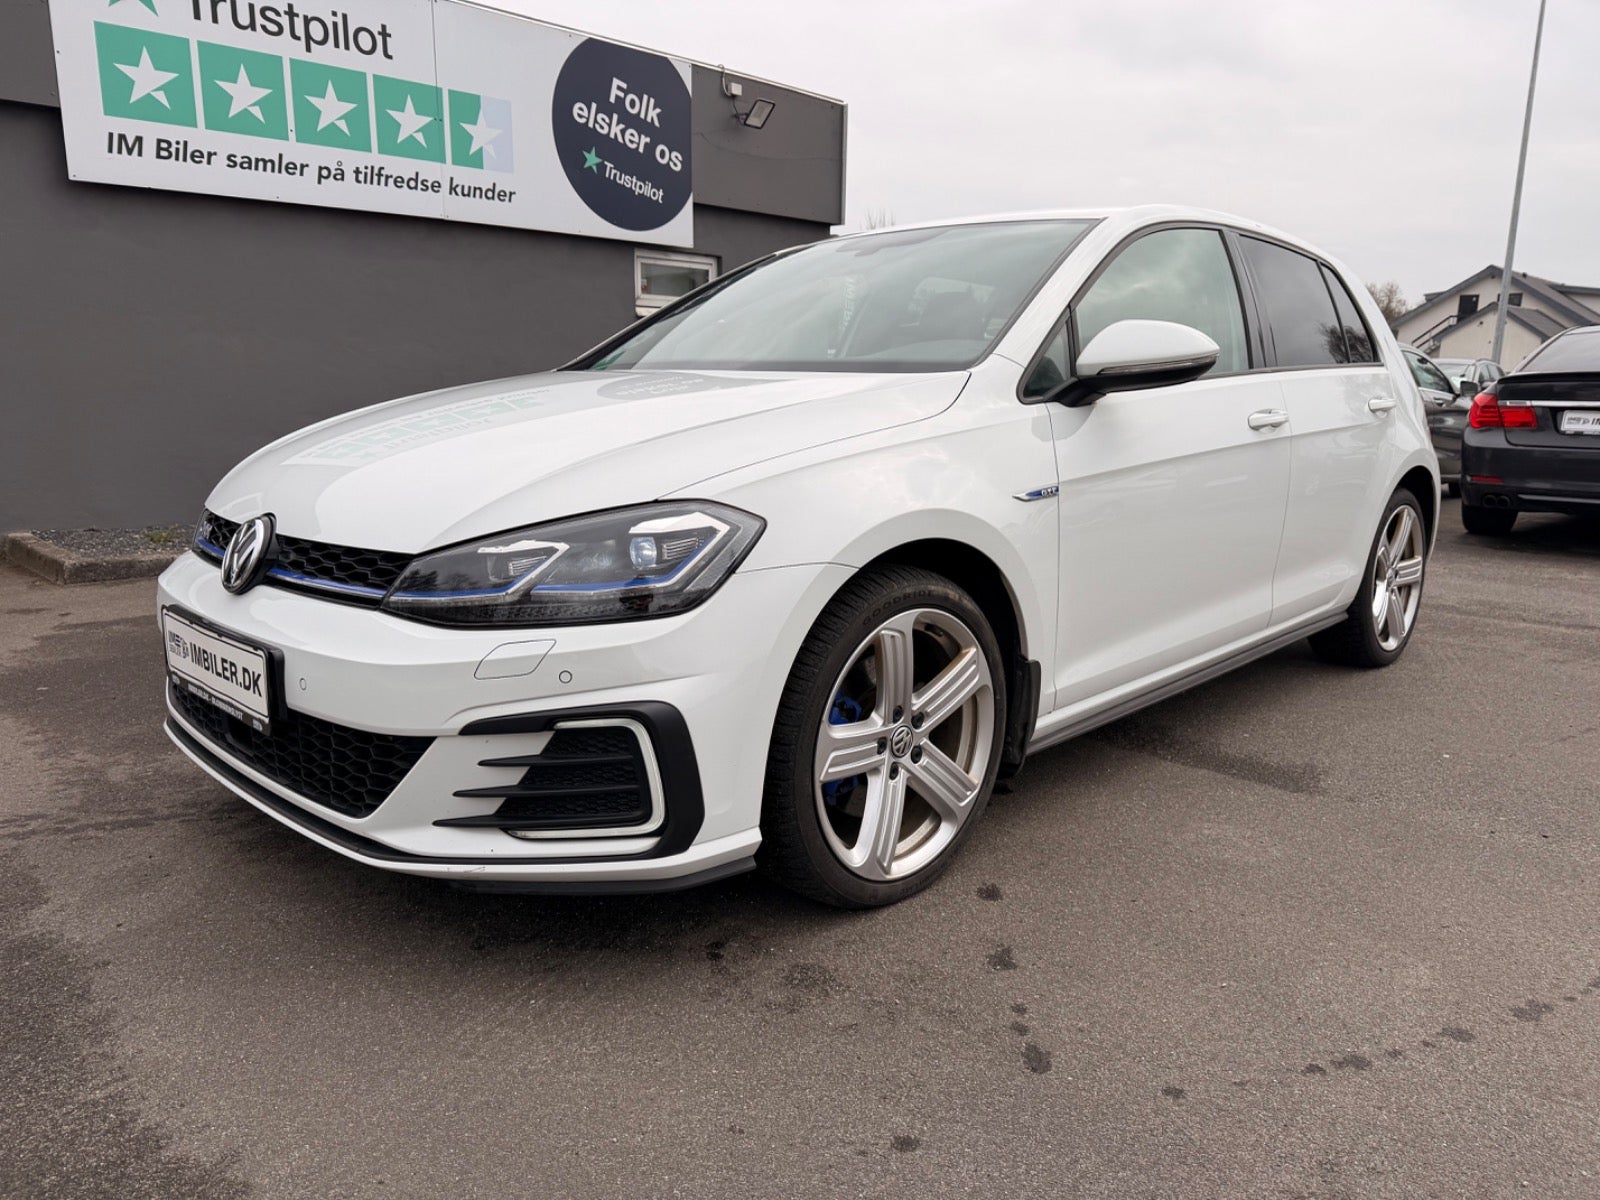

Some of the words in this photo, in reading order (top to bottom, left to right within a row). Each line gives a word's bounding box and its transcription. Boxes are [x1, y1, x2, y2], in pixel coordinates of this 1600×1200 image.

[608, 76, 662, 128] Folk
[572, 101, 651, 154] elsker
[654, 143, 683, 172] os
[106, 131, 144, 158] IM
[155, 137, 218, 166] Biler
[225, 153, 310, 177] samler
[317, 160, 346, 185] på
[352, 164, 442, 194] tilfredse
[448, 176, 517, 203] kunder
[603, 160, 665, 204] Trustpilot
[189, 641, 263, 698] IMBILER.DK
